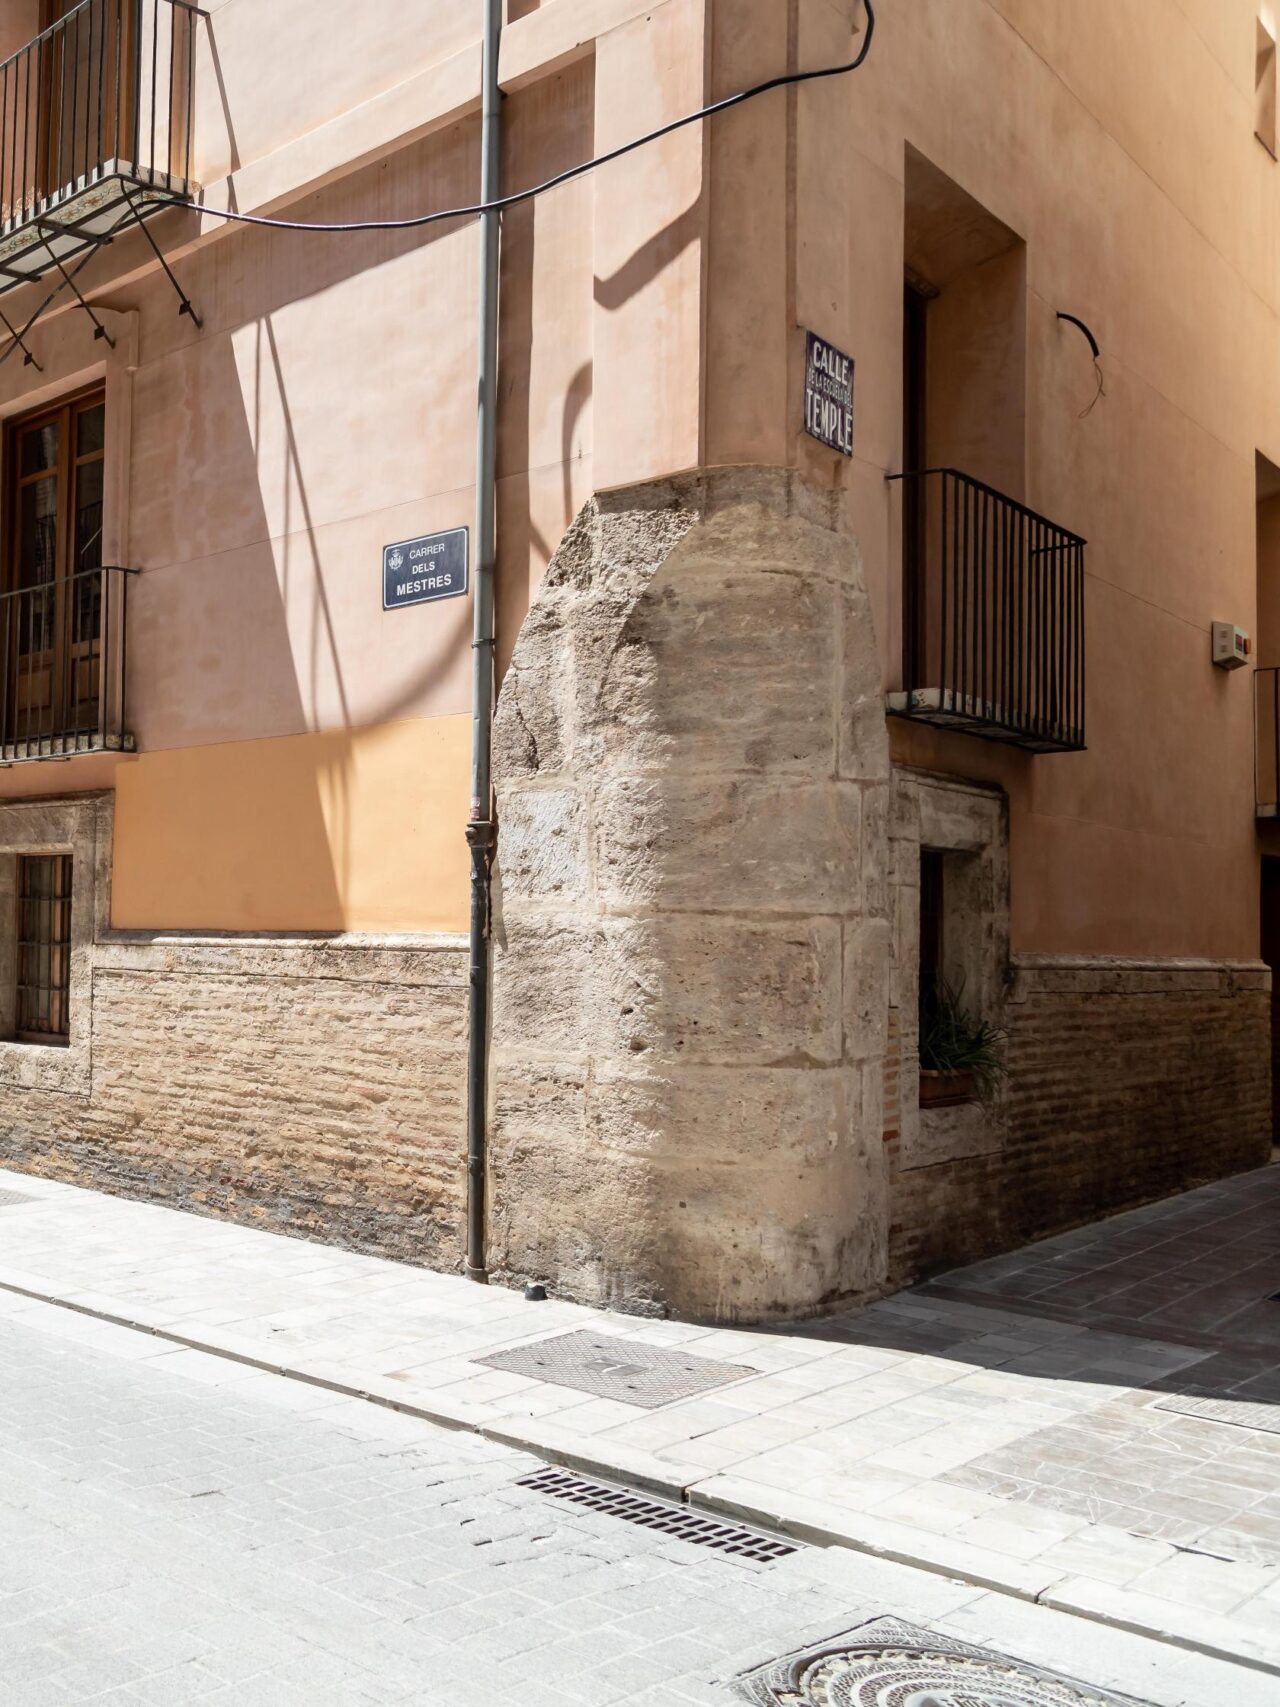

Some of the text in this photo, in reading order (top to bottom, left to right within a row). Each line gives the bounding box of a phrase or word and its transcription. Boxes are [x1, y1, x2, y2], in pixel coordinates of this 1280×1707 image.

[813, 340, 848, 386] CALLE
[806, 388, 853, 452] TEMPLE
[409, 543, 445, 560] CARRER
[412, 561, 436, 575] DELS
[396, 573, 452, 597] MESTRES
